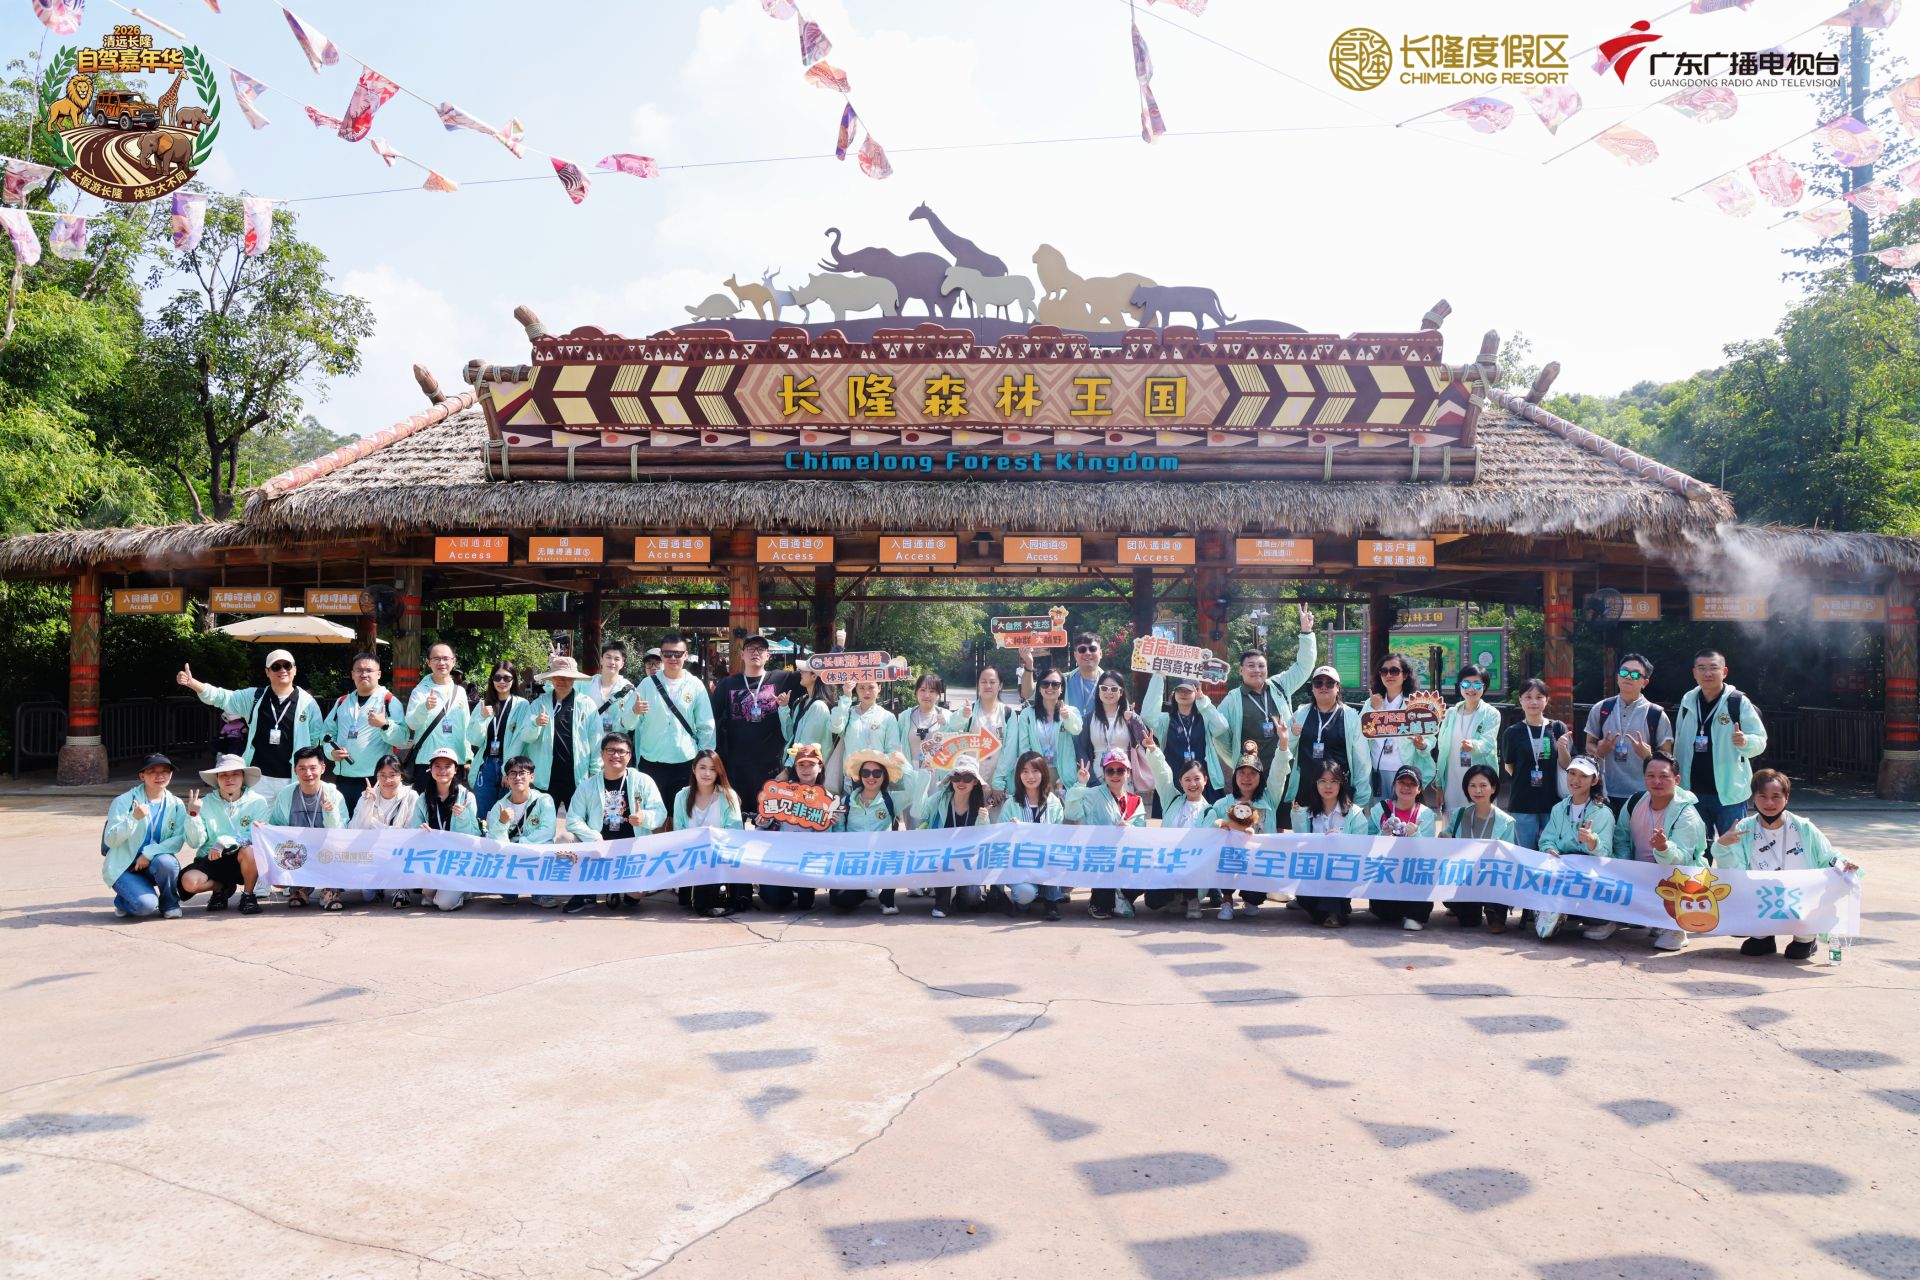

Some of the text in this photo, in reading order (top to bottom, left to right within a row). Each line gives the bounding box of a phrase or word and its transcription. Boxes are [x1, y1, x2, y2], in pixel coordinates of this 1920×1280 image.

[777, 372, 1188, 418] 长隆森林王国
[785, 451, 1180, 474] Chimelong Forest Kingdom
[1372, 542, 1416, 552] 清远户籍
[449, 551, 491, 560] Access
[648, 551, 692, 560] Access
[772, 552, 815, 561] Access
[895, 552, 937, 561] Access
[1026, 552, 1059, 561] Access
[1134, 553, 1175, 562] Access
[997, 619, 1051, 631] 大自然 大生态
[1141, 636, 1202, 660] 首届清远长隆
[822, 652, 882, 668] 长假游长隆
[1152, 657, 1205, 679] 自驾嘉年华
[826, 669, 886, 682] 体验大不同
[1370, 711, 1406, 724] 27公里
[936, 736, 993, 765] 从清远出发
